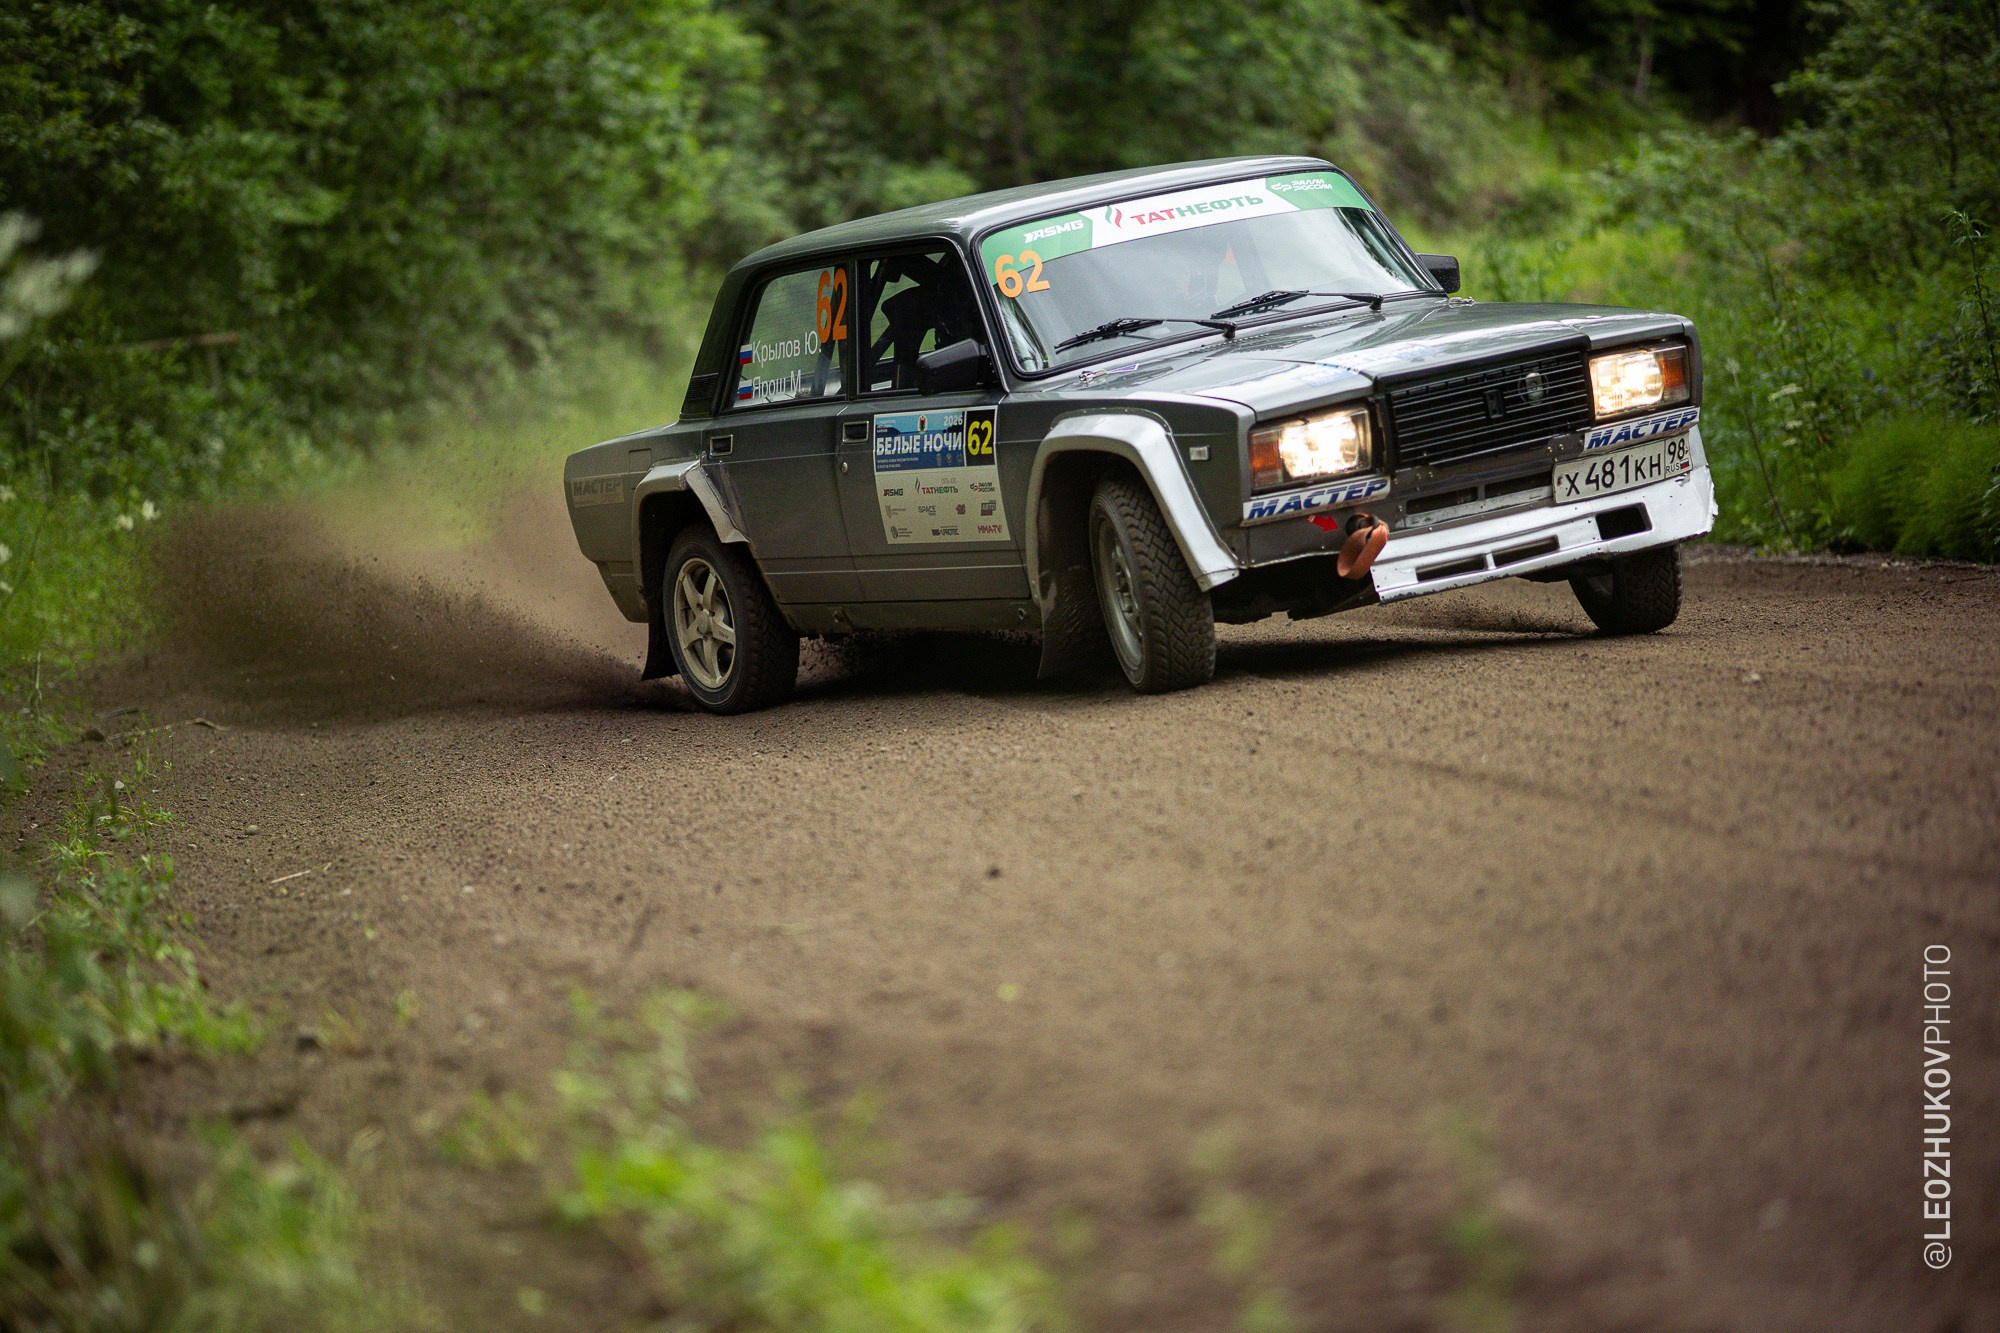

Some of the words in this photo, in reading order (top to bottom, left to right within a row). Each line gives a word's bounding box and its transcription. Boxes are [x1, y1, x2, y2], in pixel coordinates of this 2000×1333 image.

[1130, 194, 1264, 226] ТАТНЕФТЬ
[994, 250, 1050, 298] 62
[816, 267, 848, 344] 62
[752, 339, 801, 368] Крылов
[804, 330, 822, 355] Ю.
[752, 375, 786, 400] Ярош
[943, 415, 963, 426] 2026
[1587, 410, 1698, 450] МАСТЕР
[876, 434, 921, 456] БЕЛЫЕ
[923, 431, 962, 453] НОЧИ
[967, 420, 993, 456] 62
[1667, 437, 1686, 464] 98
[1666, 463, 1680, 474] RUS
[921, 485, 959, 495] ТАТНЕФТЬ
[1248, 479, 1388, 520] МАСТЕР
